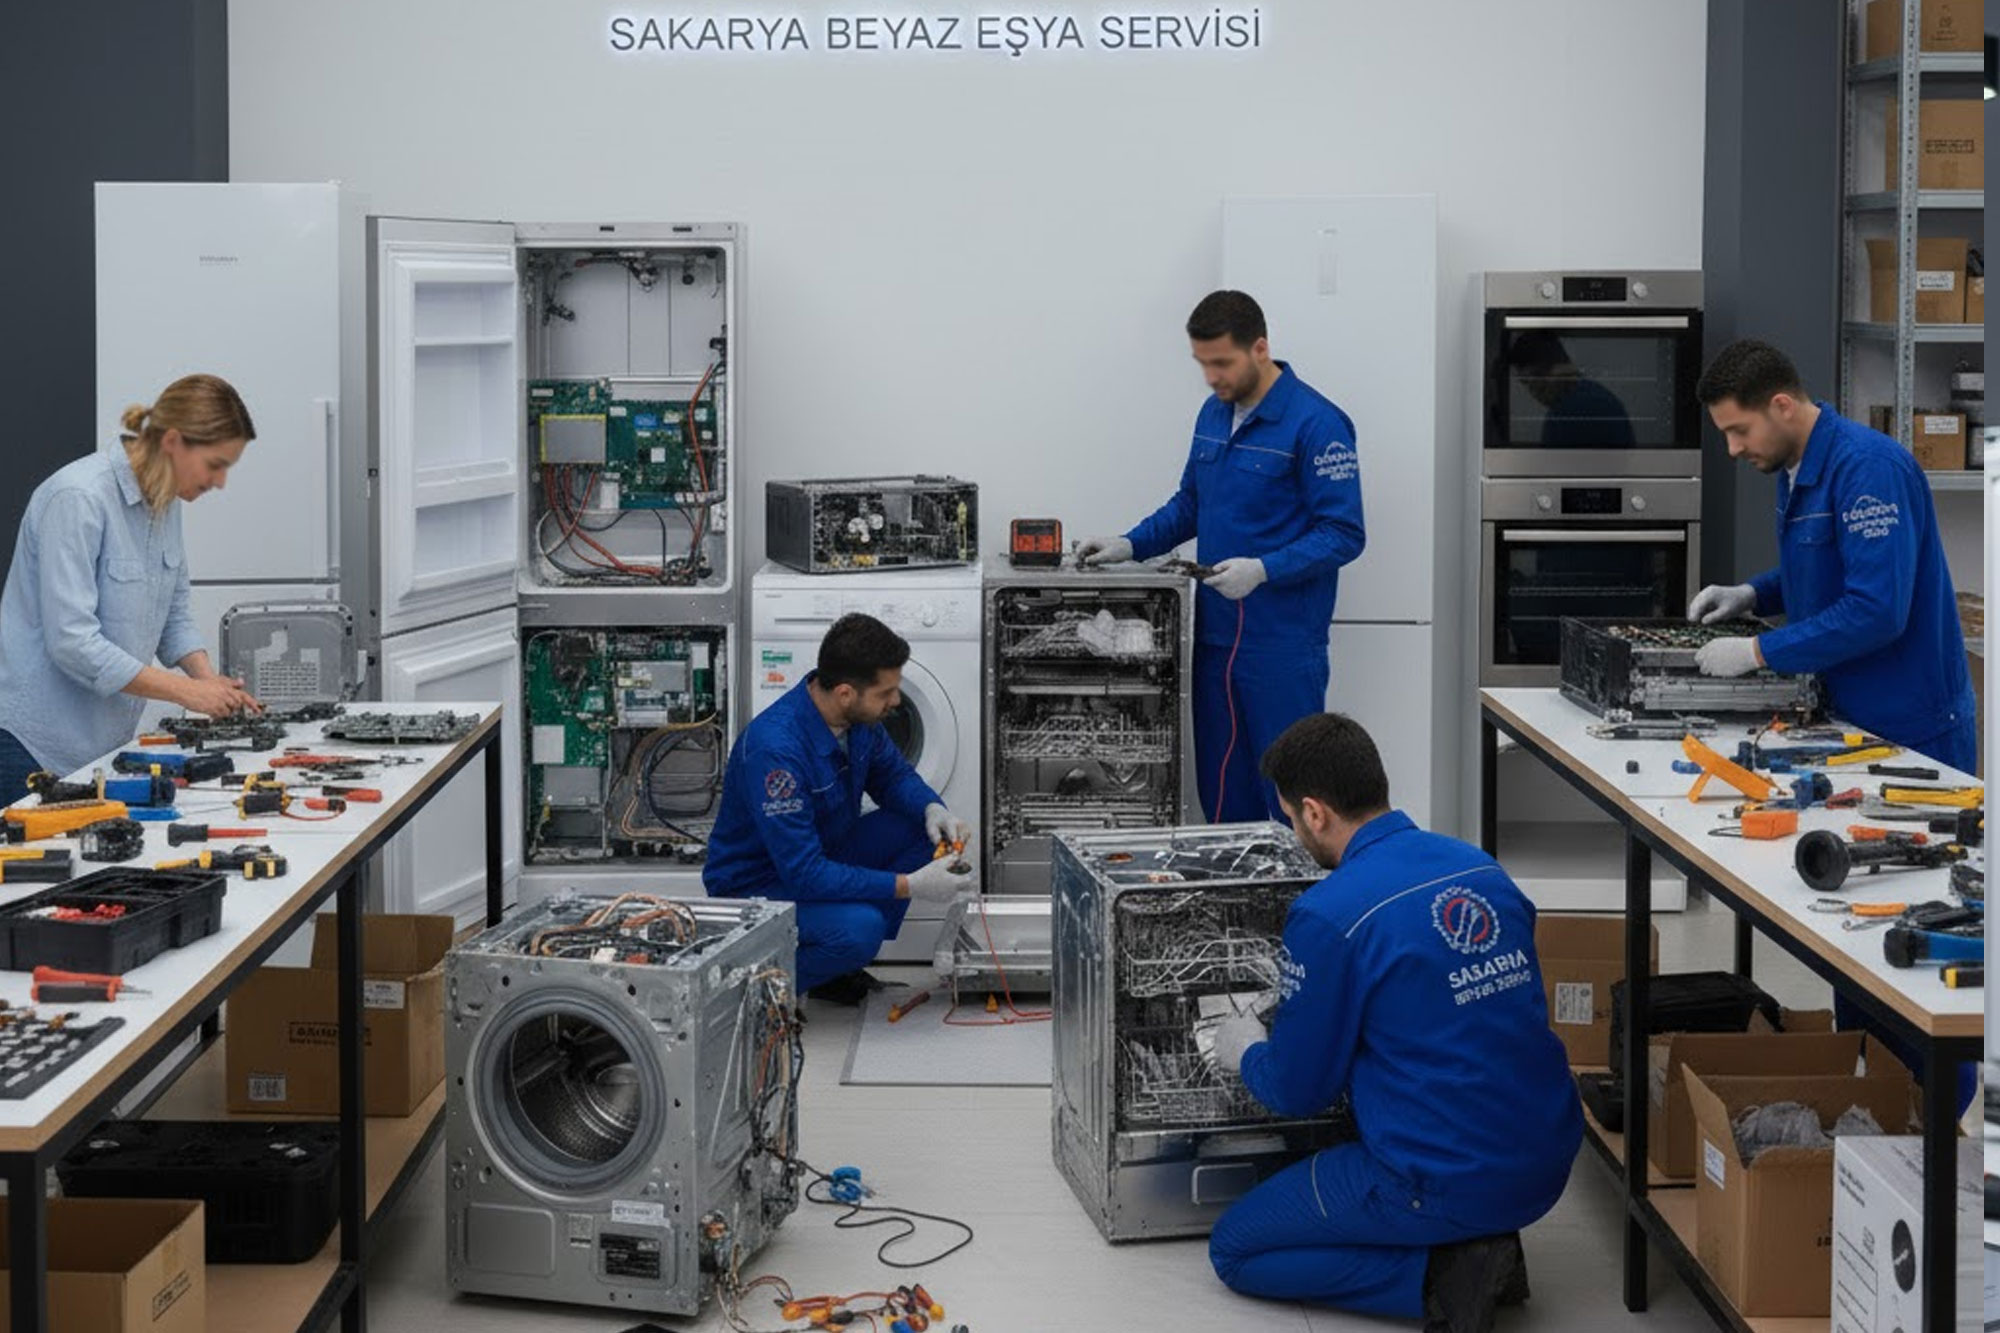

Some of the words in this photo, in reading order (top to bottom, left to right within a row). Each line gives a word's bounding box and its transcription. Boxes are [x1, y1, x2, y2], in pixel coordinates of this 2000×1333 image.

[610, 17, 809, 51] SAKARYA
[827, 17, 962, 50] BEYAZ
[978, 16, 1084, 57] EŞYA
[1100, 8, 1260, 49] SERVİSİ
